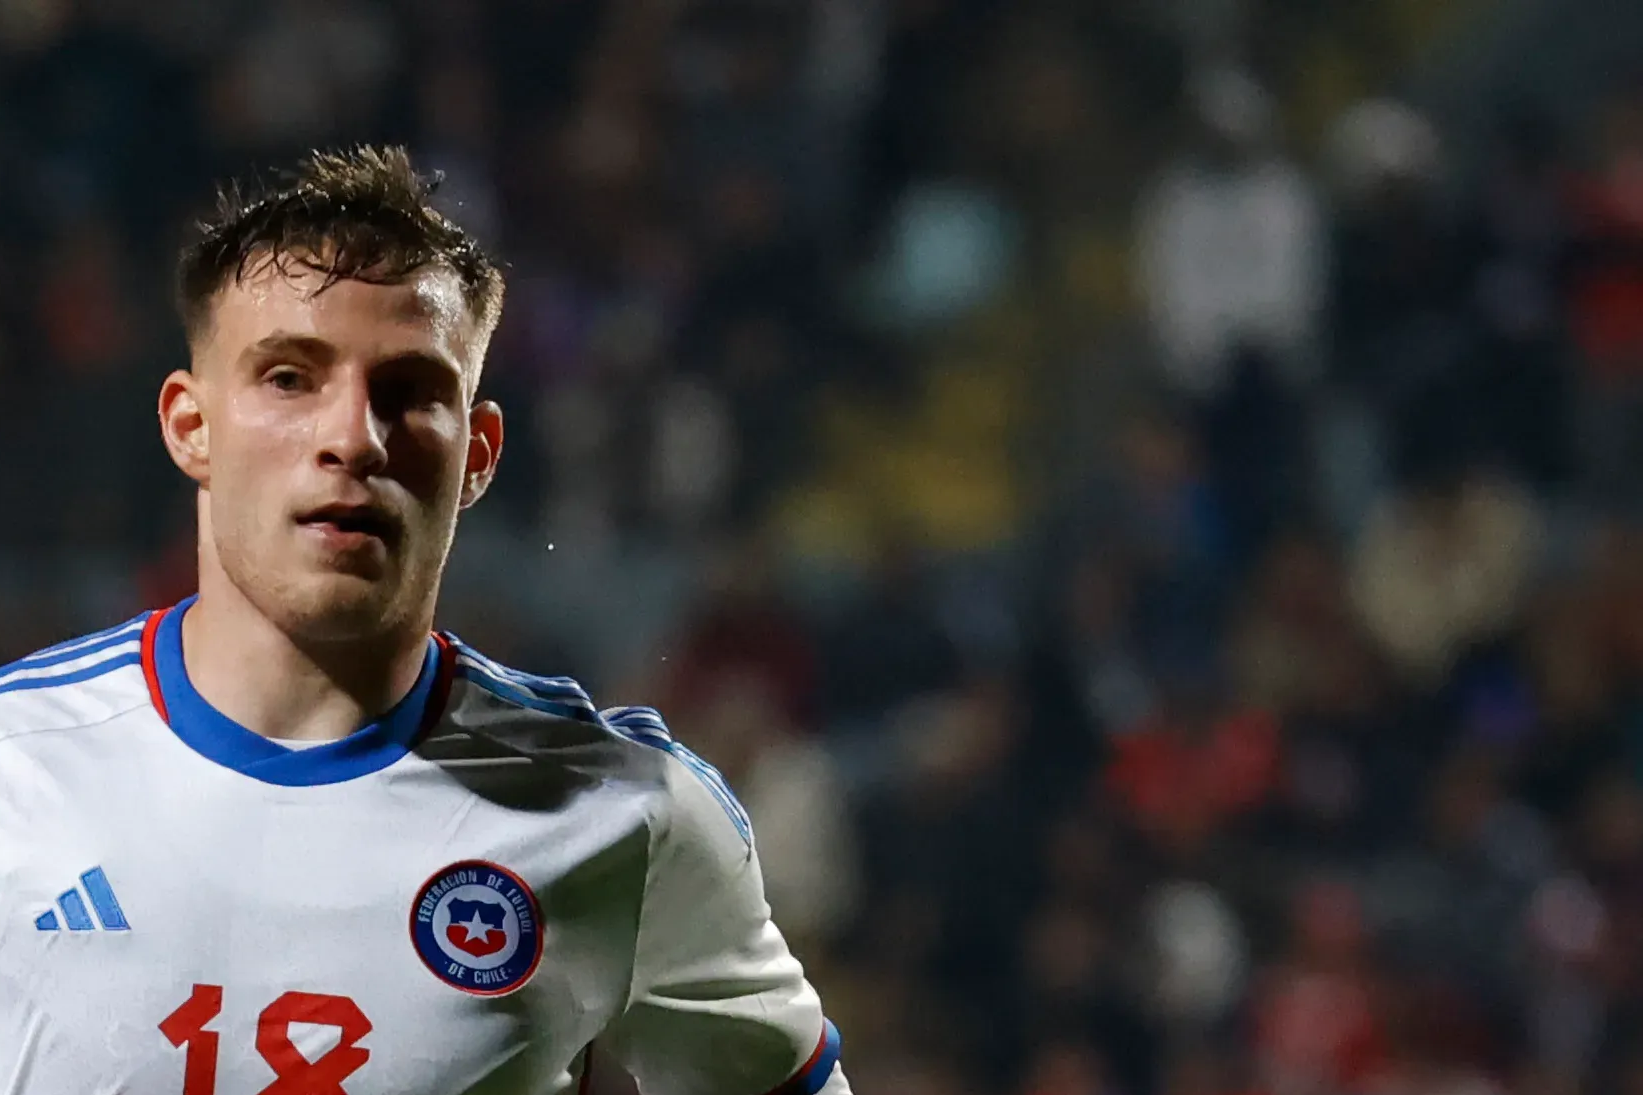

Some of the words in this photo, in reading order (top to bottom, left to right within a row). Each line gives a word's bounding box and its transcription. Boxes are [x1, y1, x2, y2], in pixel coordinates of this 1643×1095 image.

[418, 870, 477, 922] FEDERACION
[486, 874, 505, 889] DE
[447, 962, 467, 979] DE
[474, 967, 509, 984] CHILE
